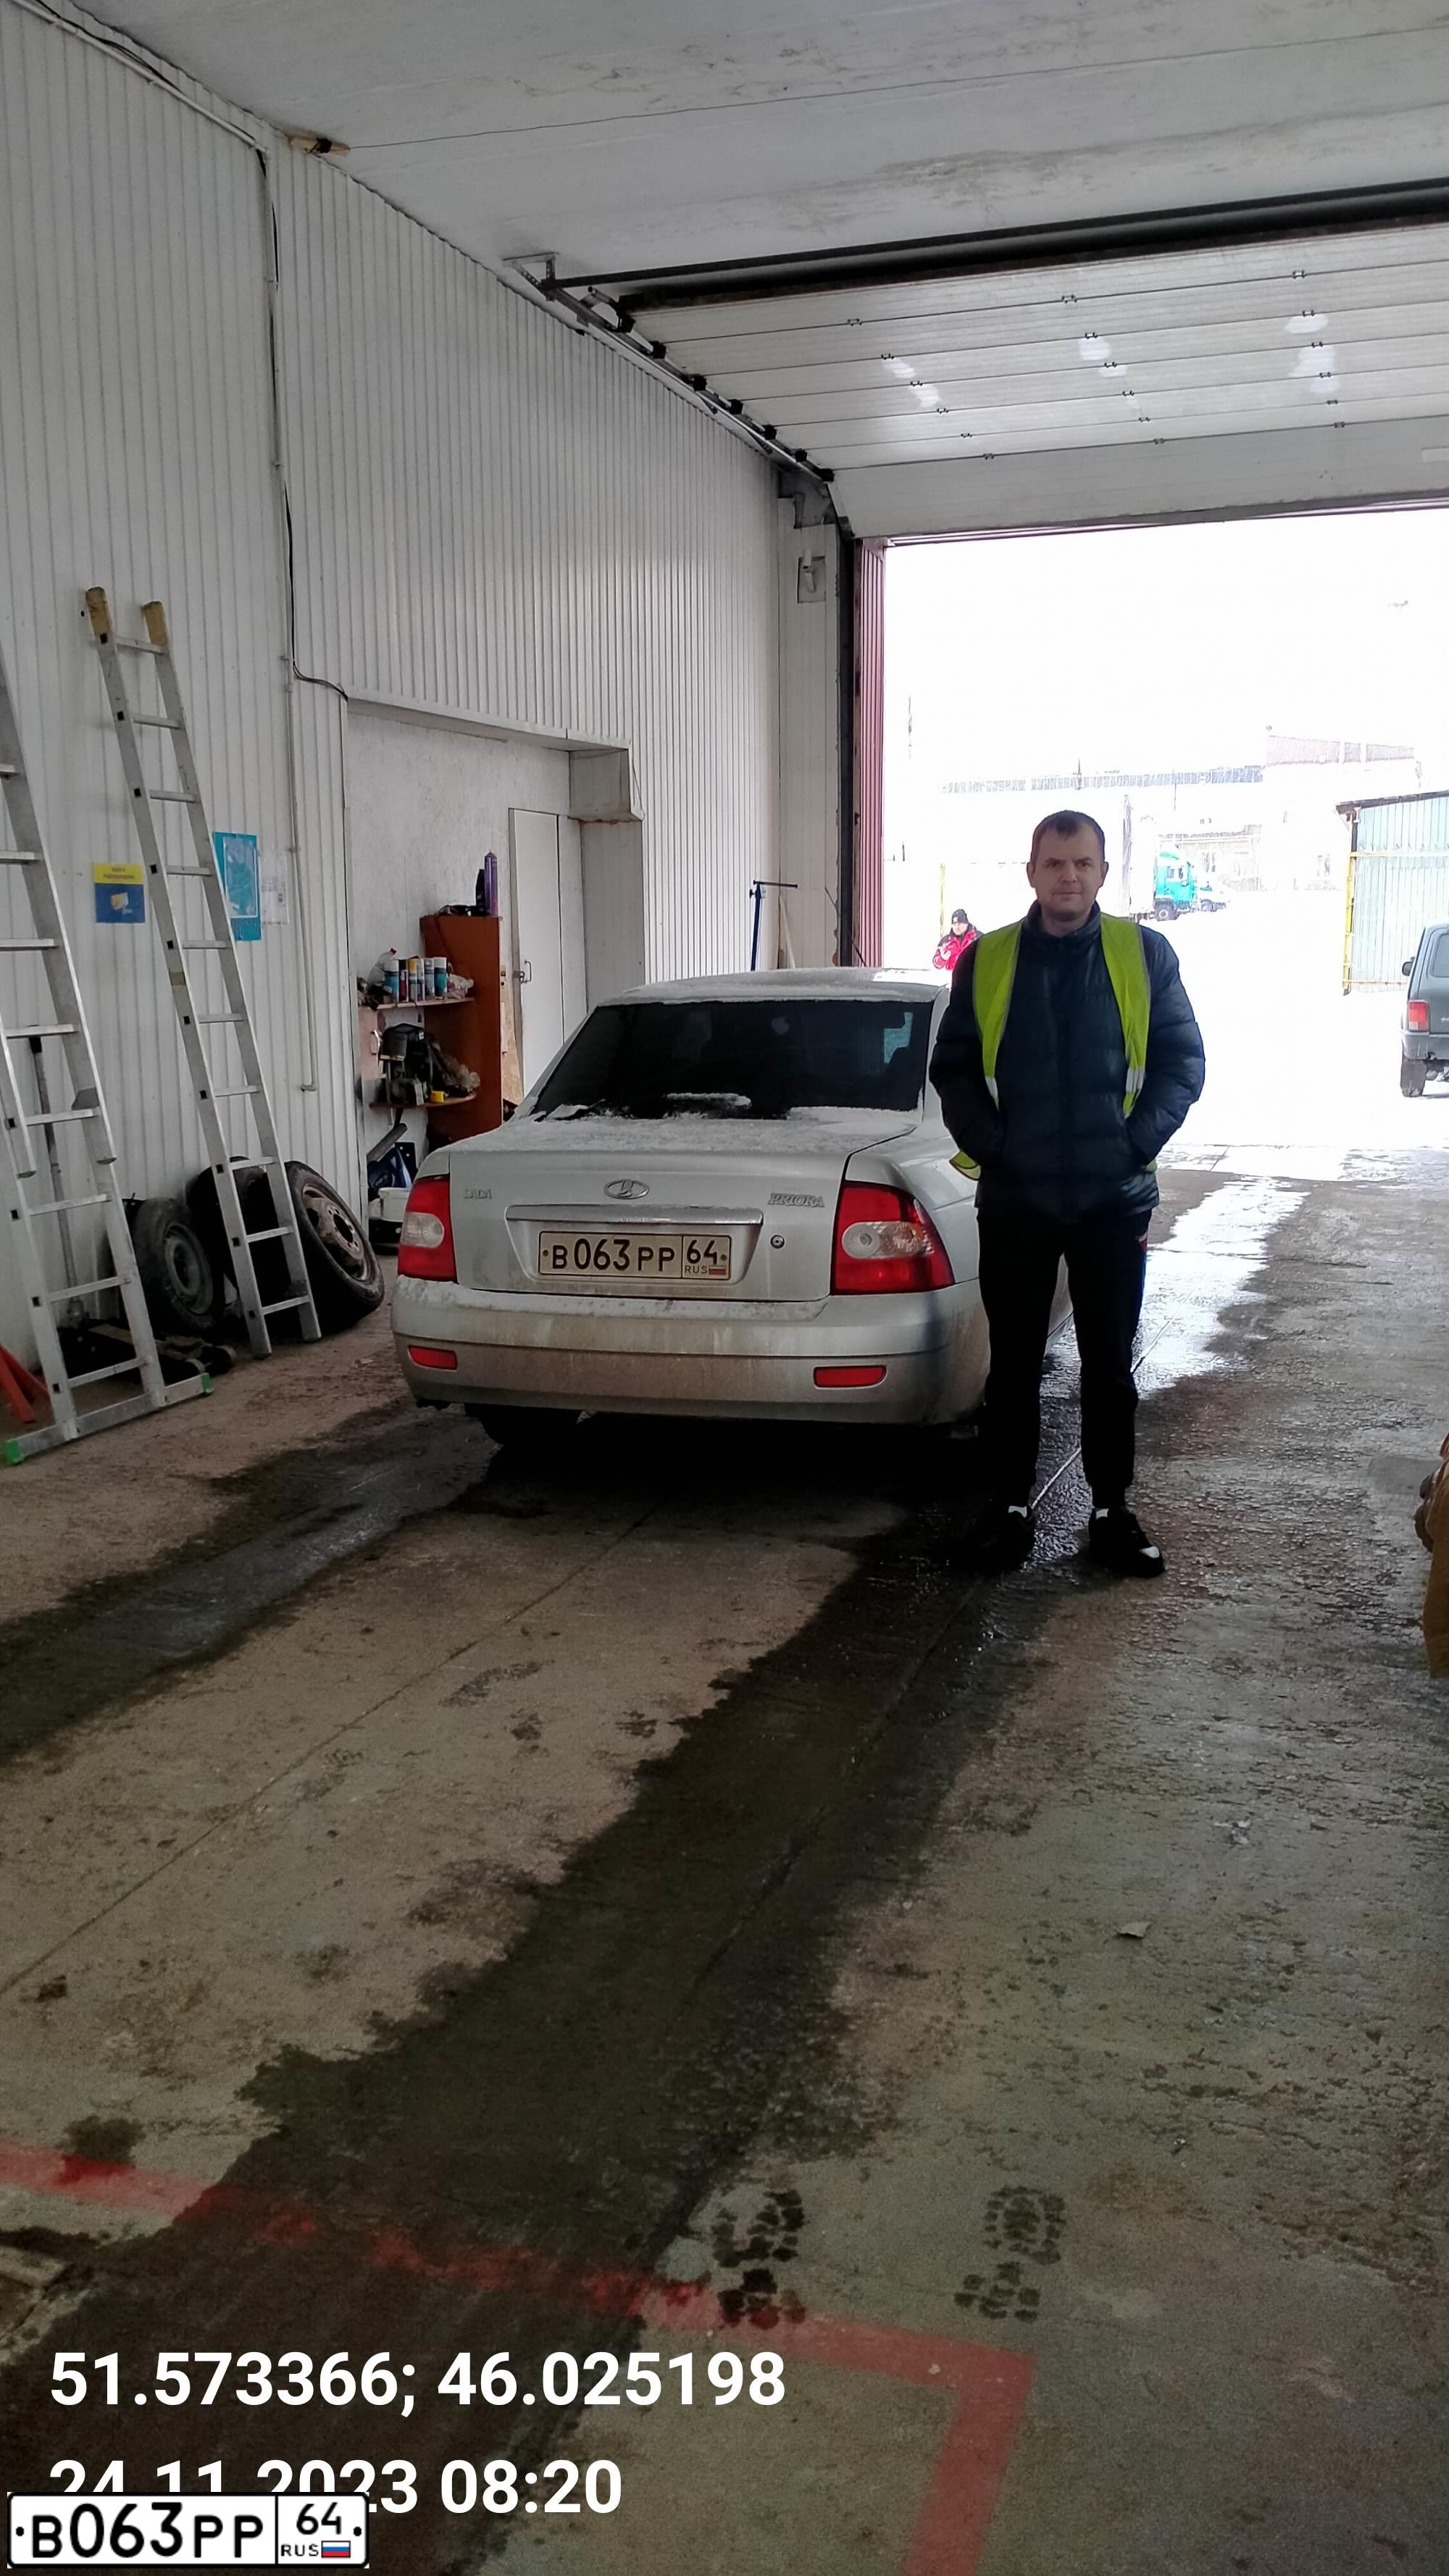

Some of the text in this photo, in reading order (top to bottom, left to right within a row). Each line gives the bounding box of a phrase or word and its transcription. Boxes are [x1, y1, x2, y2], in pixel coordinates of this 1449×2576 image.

[768, 1193, 825, 1208] PRIORA
[686, 1239, 717, 1265] 64
[684, 1265, 708, 1275] RUS
